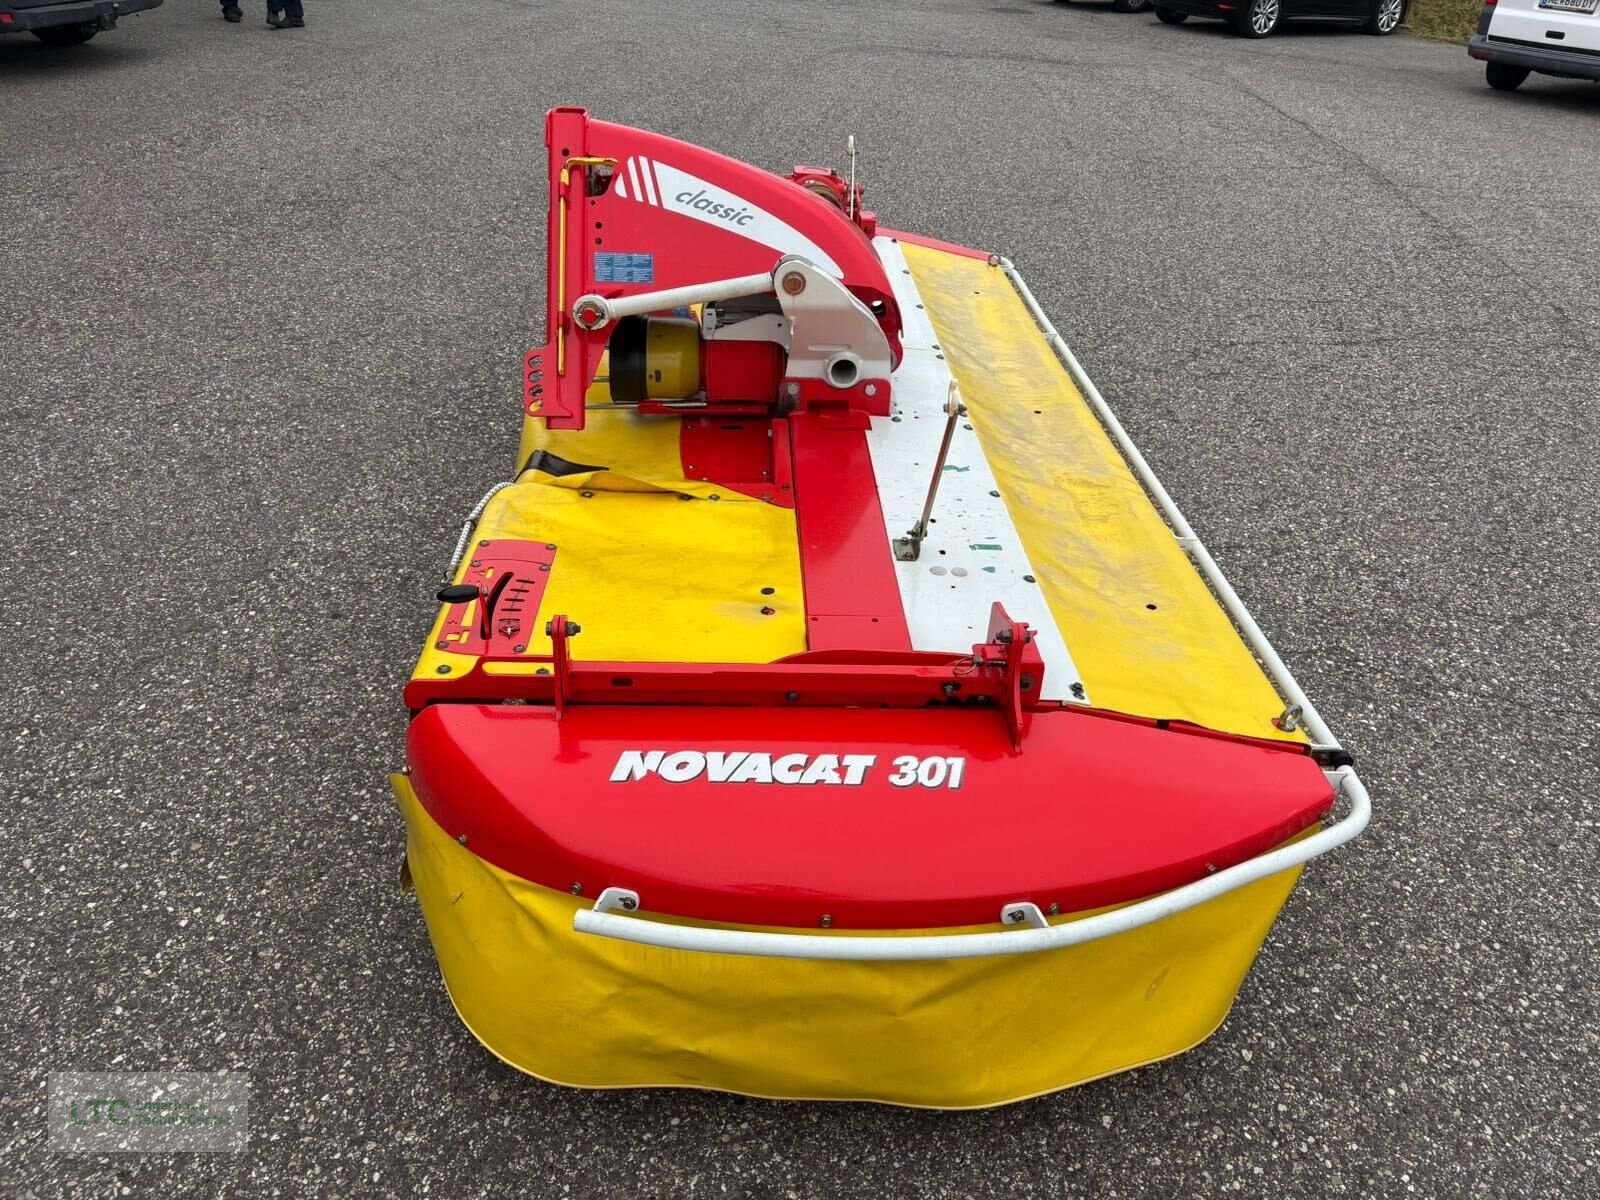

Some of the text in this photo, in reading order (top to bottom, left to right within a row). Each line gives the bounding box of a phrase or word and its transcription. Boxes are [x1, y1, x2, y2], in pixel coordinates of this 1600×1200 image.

[675, 190, 754, 226] classic
[609, 751, 965, 789] NOVACAT 301
